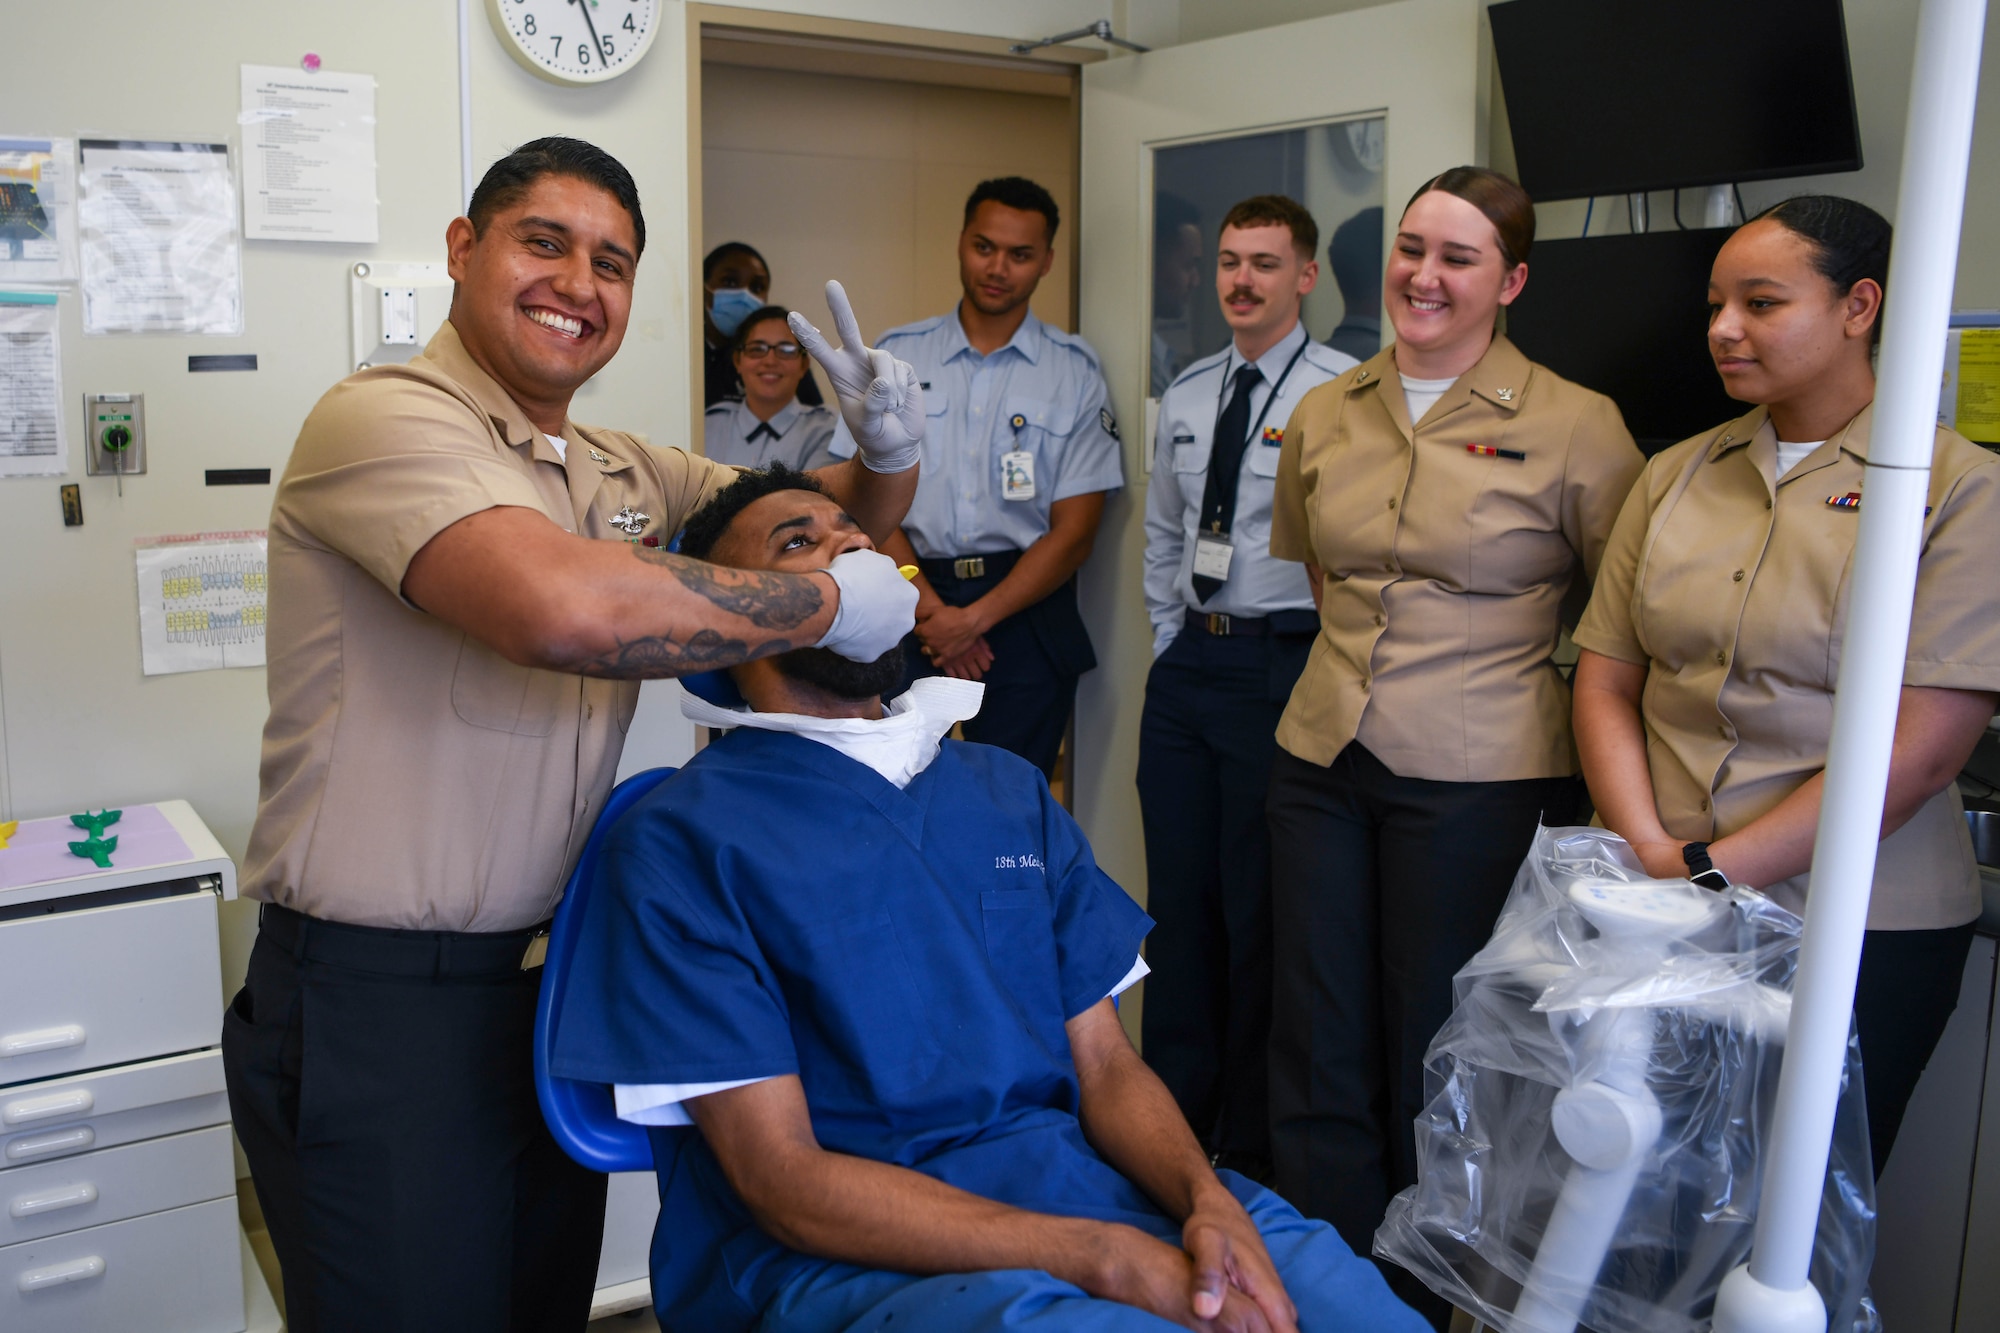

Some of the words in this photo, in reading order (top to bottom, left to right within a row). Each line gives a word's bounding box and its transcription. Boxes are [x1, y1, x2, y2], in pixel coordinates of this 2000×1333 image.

[524, 14, 537, 36] 8
[622, 13, 636, 34] 4
[550, 36, 563, 58] 7
[578, 44, 590, 65] 6
[602, 35, 615, 56] 5
[995, 855, 1016, 869] 18th
